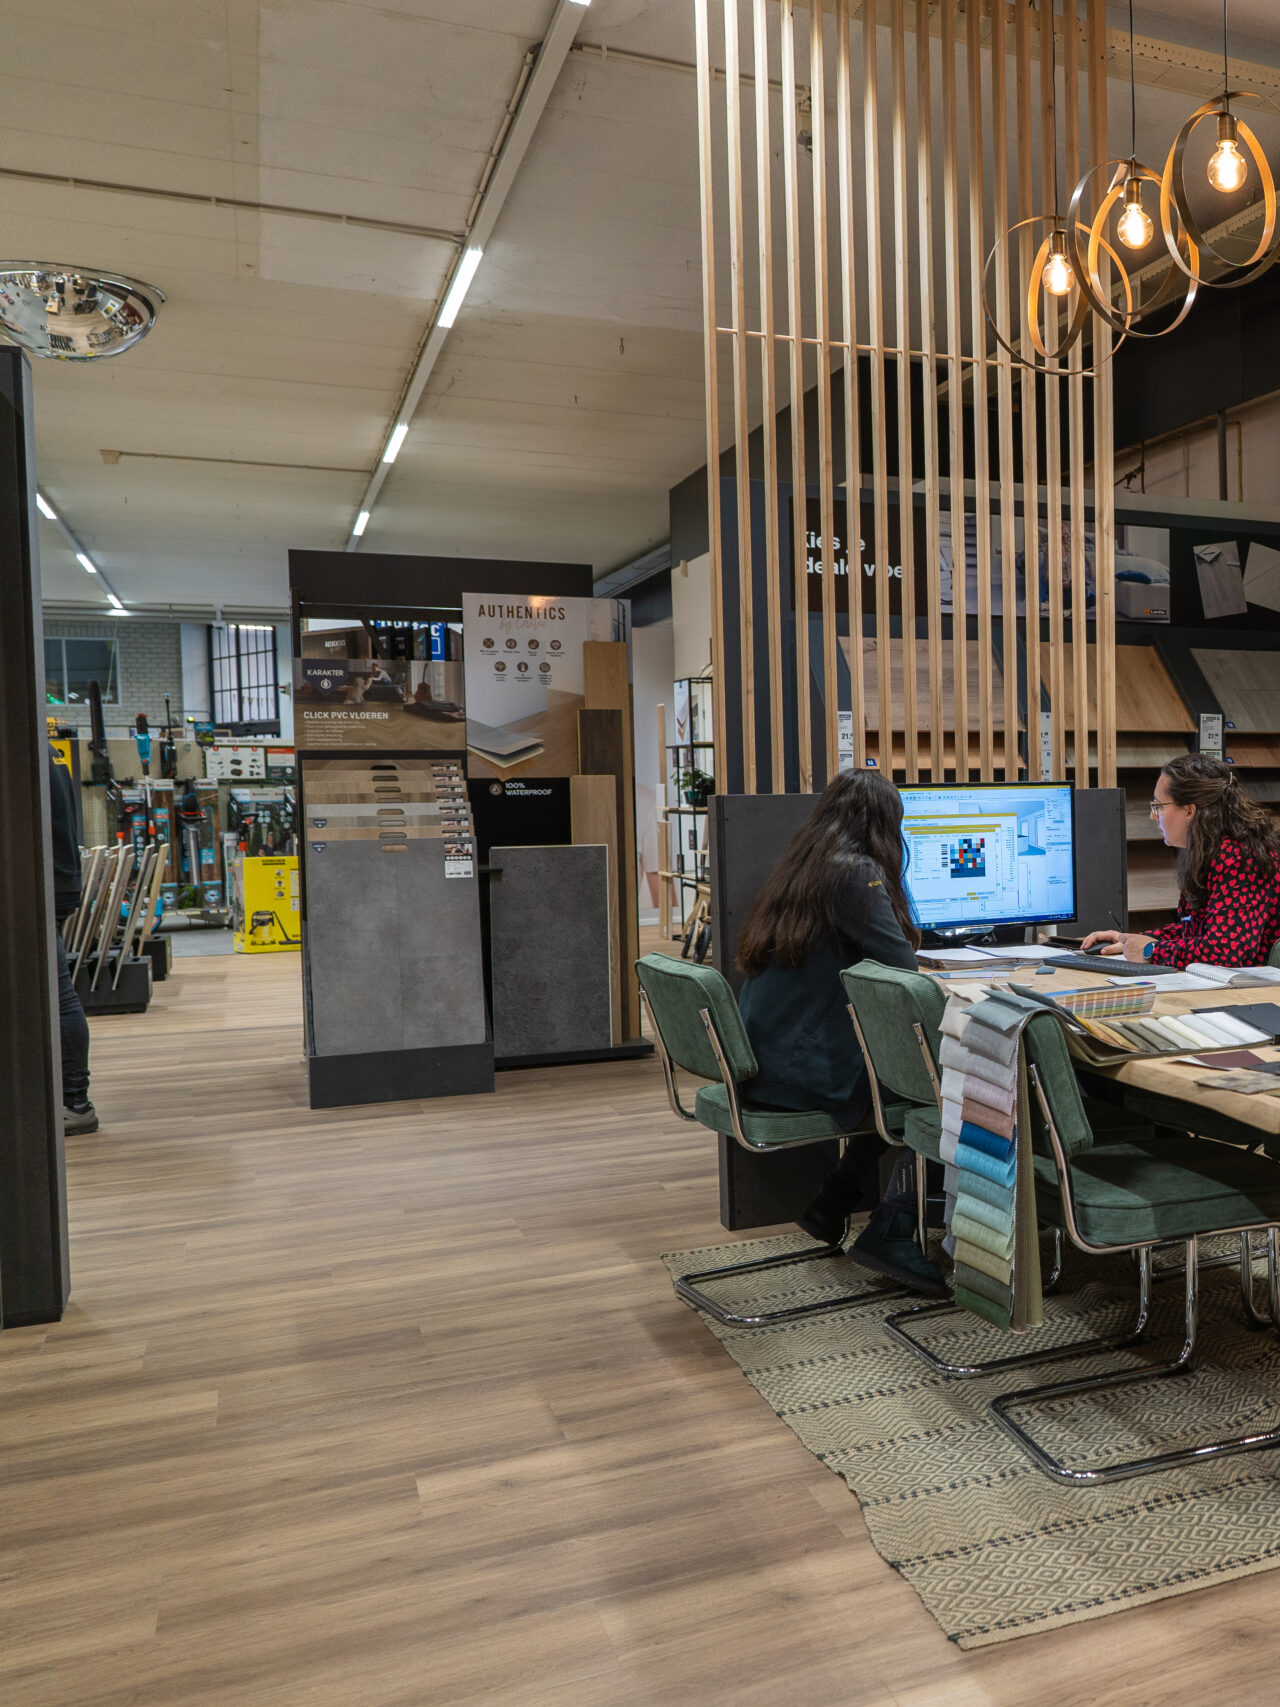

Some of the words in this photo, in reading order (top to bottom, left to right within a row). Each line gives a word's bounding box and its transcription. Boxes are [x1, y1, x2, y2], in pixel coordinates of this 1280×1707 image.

[478, 604, 566, 620] AUTHENTICS
[307, 669, 344, 677] KARAKTER
[303, 711, 329, 719] CLICK
[331, 711, 348, 720] PVC
[350, 711, 389, 720] VLOEREN
[505, 788, 553, 796] WATERPROOF
